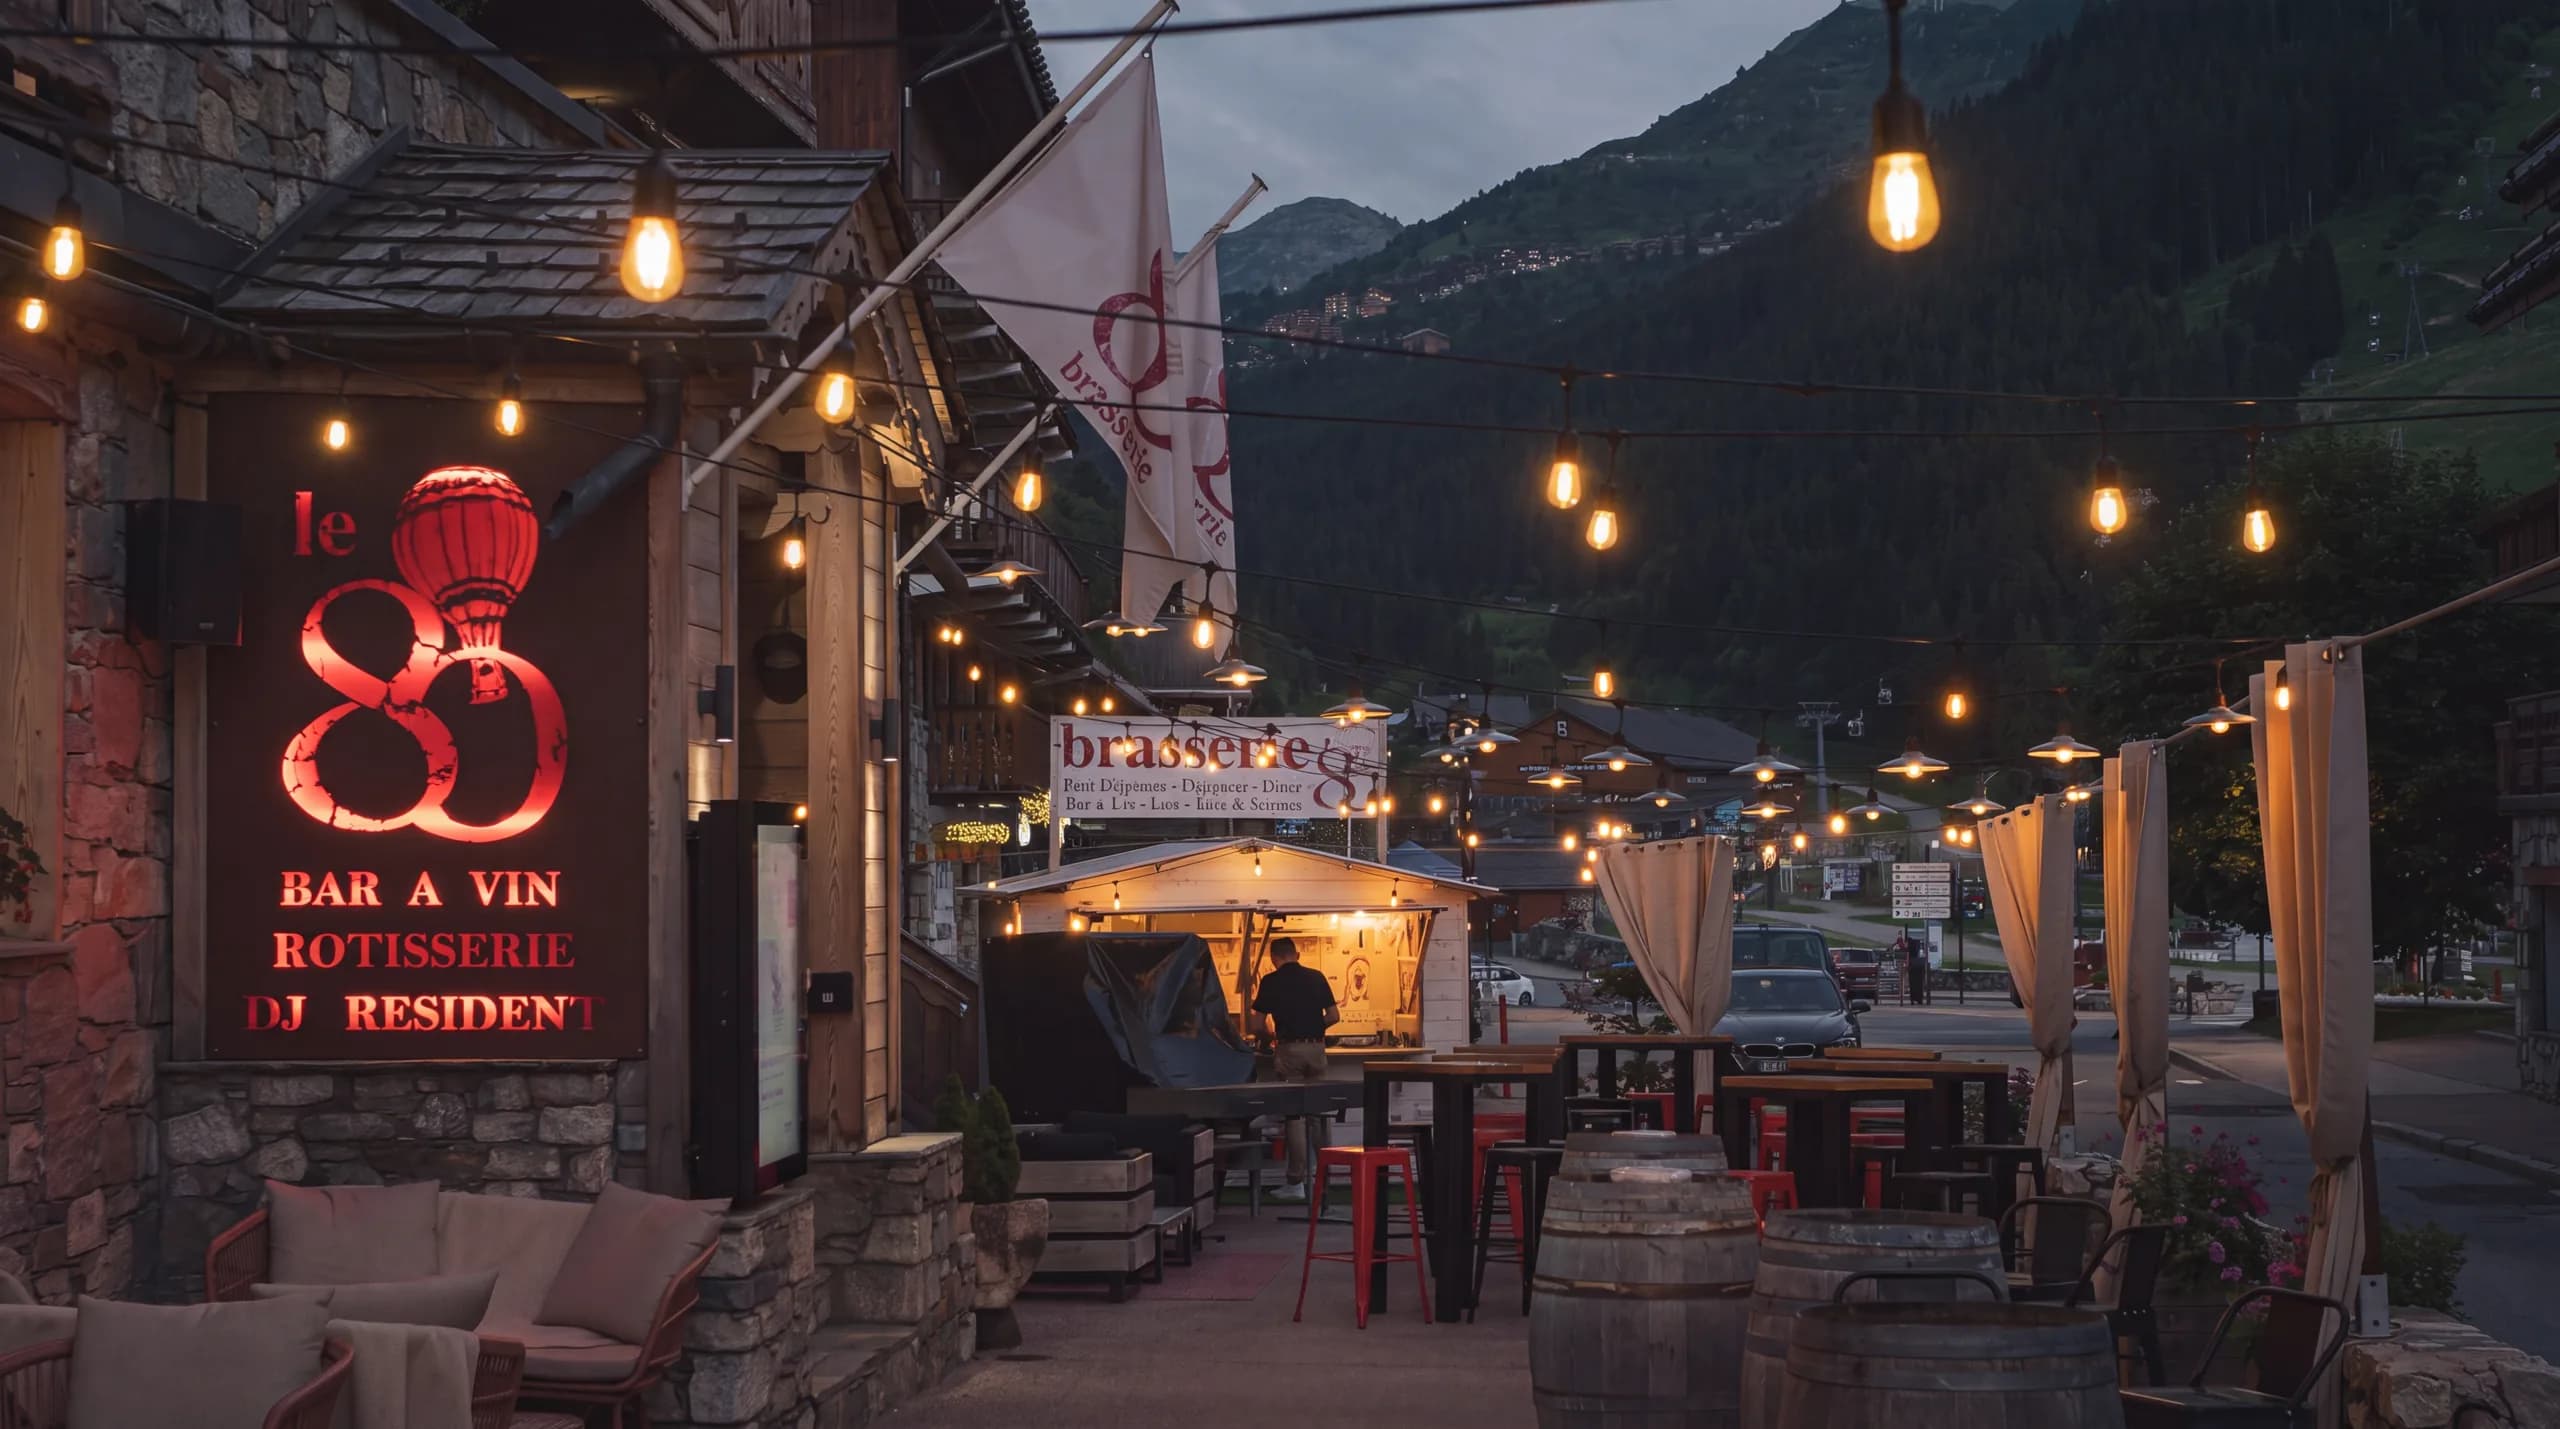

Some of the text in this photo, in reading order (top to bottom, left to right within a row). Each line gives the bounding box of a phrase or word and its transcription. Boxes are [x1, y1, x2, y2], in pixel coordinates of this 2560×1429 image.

[1060, 350, 1153, 484] brasserie
[294, 490, 357, 556] le
[1061, 723, 1310, 770] brasserie
[279, 870, 561, 908] BAR A VIN
[273, 931, 575, 970] ROTISSERIE
[245, 994, 606, 1033] DJ RESIDENT
